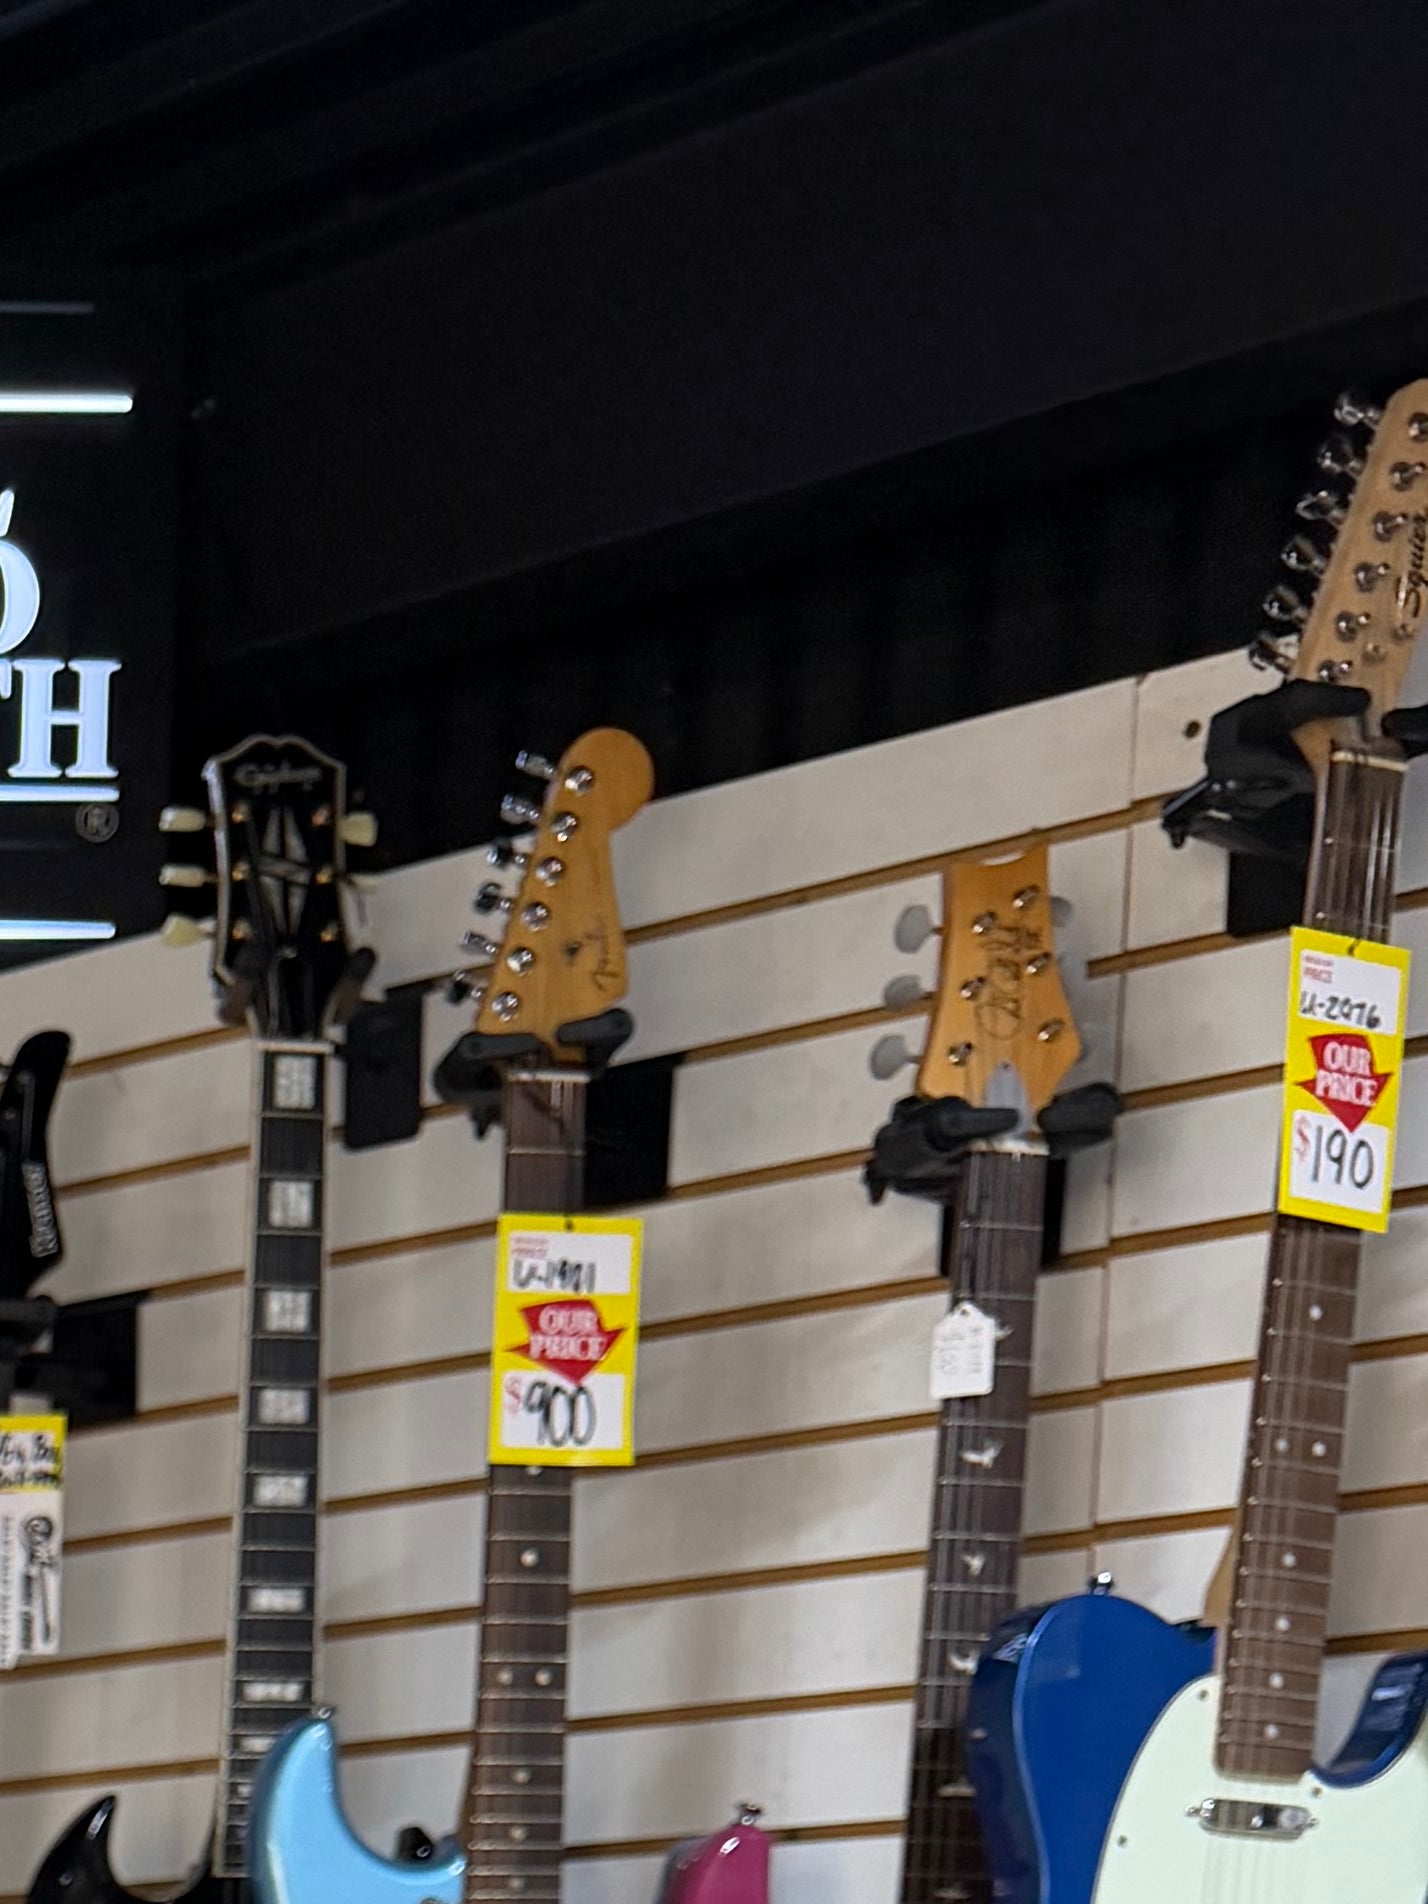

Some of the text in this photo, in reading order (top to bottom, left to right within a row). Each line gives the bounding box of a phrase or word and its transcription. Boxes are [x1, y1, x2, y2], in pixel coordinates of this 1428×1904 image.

[1324, 1042, 1372, 1074] OUR
[1315, 1071, 1378, 1106] PRICE
[539, 1307, 597, 1335] OUR
[530, 1336, 606, 1361] PRICE
